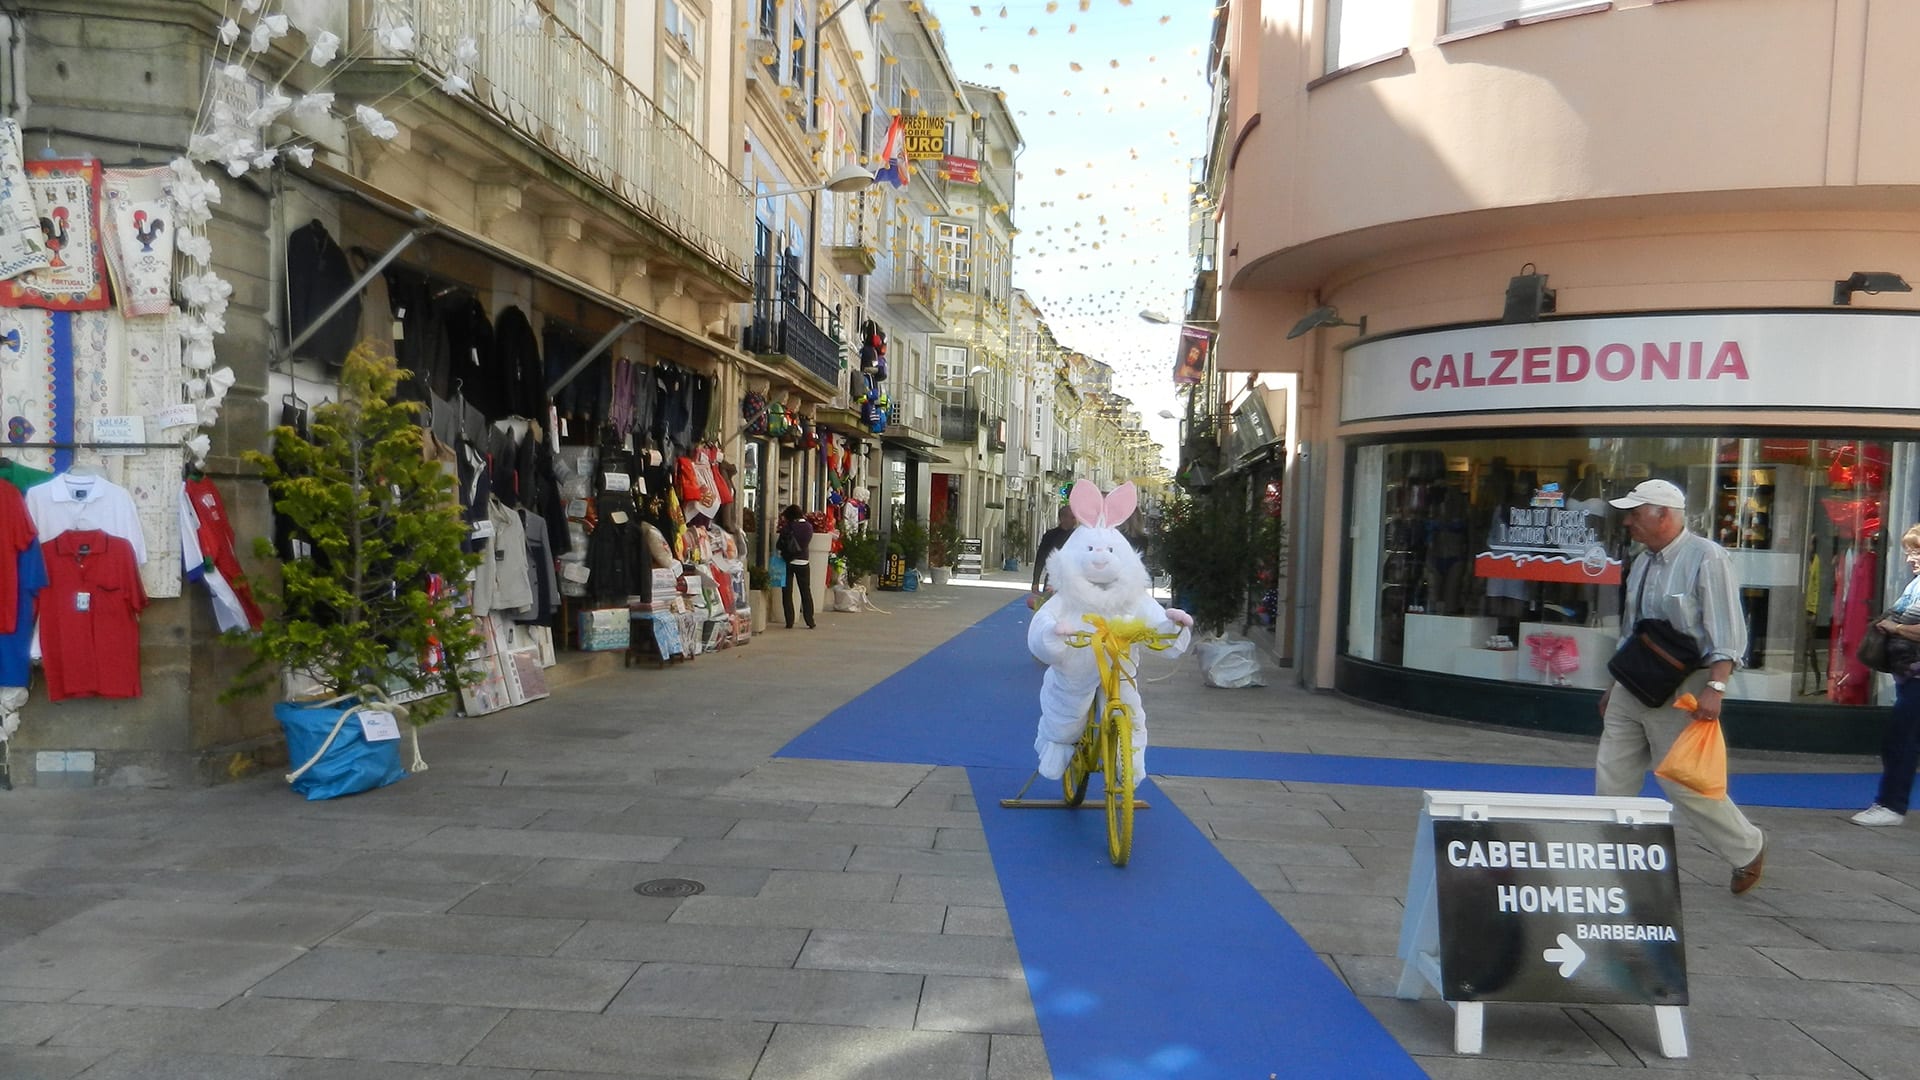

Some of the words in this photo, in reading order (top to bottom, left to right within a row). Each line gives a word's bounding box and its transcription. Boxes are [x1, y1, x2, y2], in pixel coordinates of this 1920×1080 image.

[898, 116, 944, 130] MPRESTIMOS
[906, 137, 943, 152] URO
[1410, 341, 1750, 391] CALZEDONIA
[1447, 840, 1666, 871] CABELEIREIRO
[1497, 885, 1627, 914] HOMENS
[1577, 923, 1677, 942] BARBEARIA
